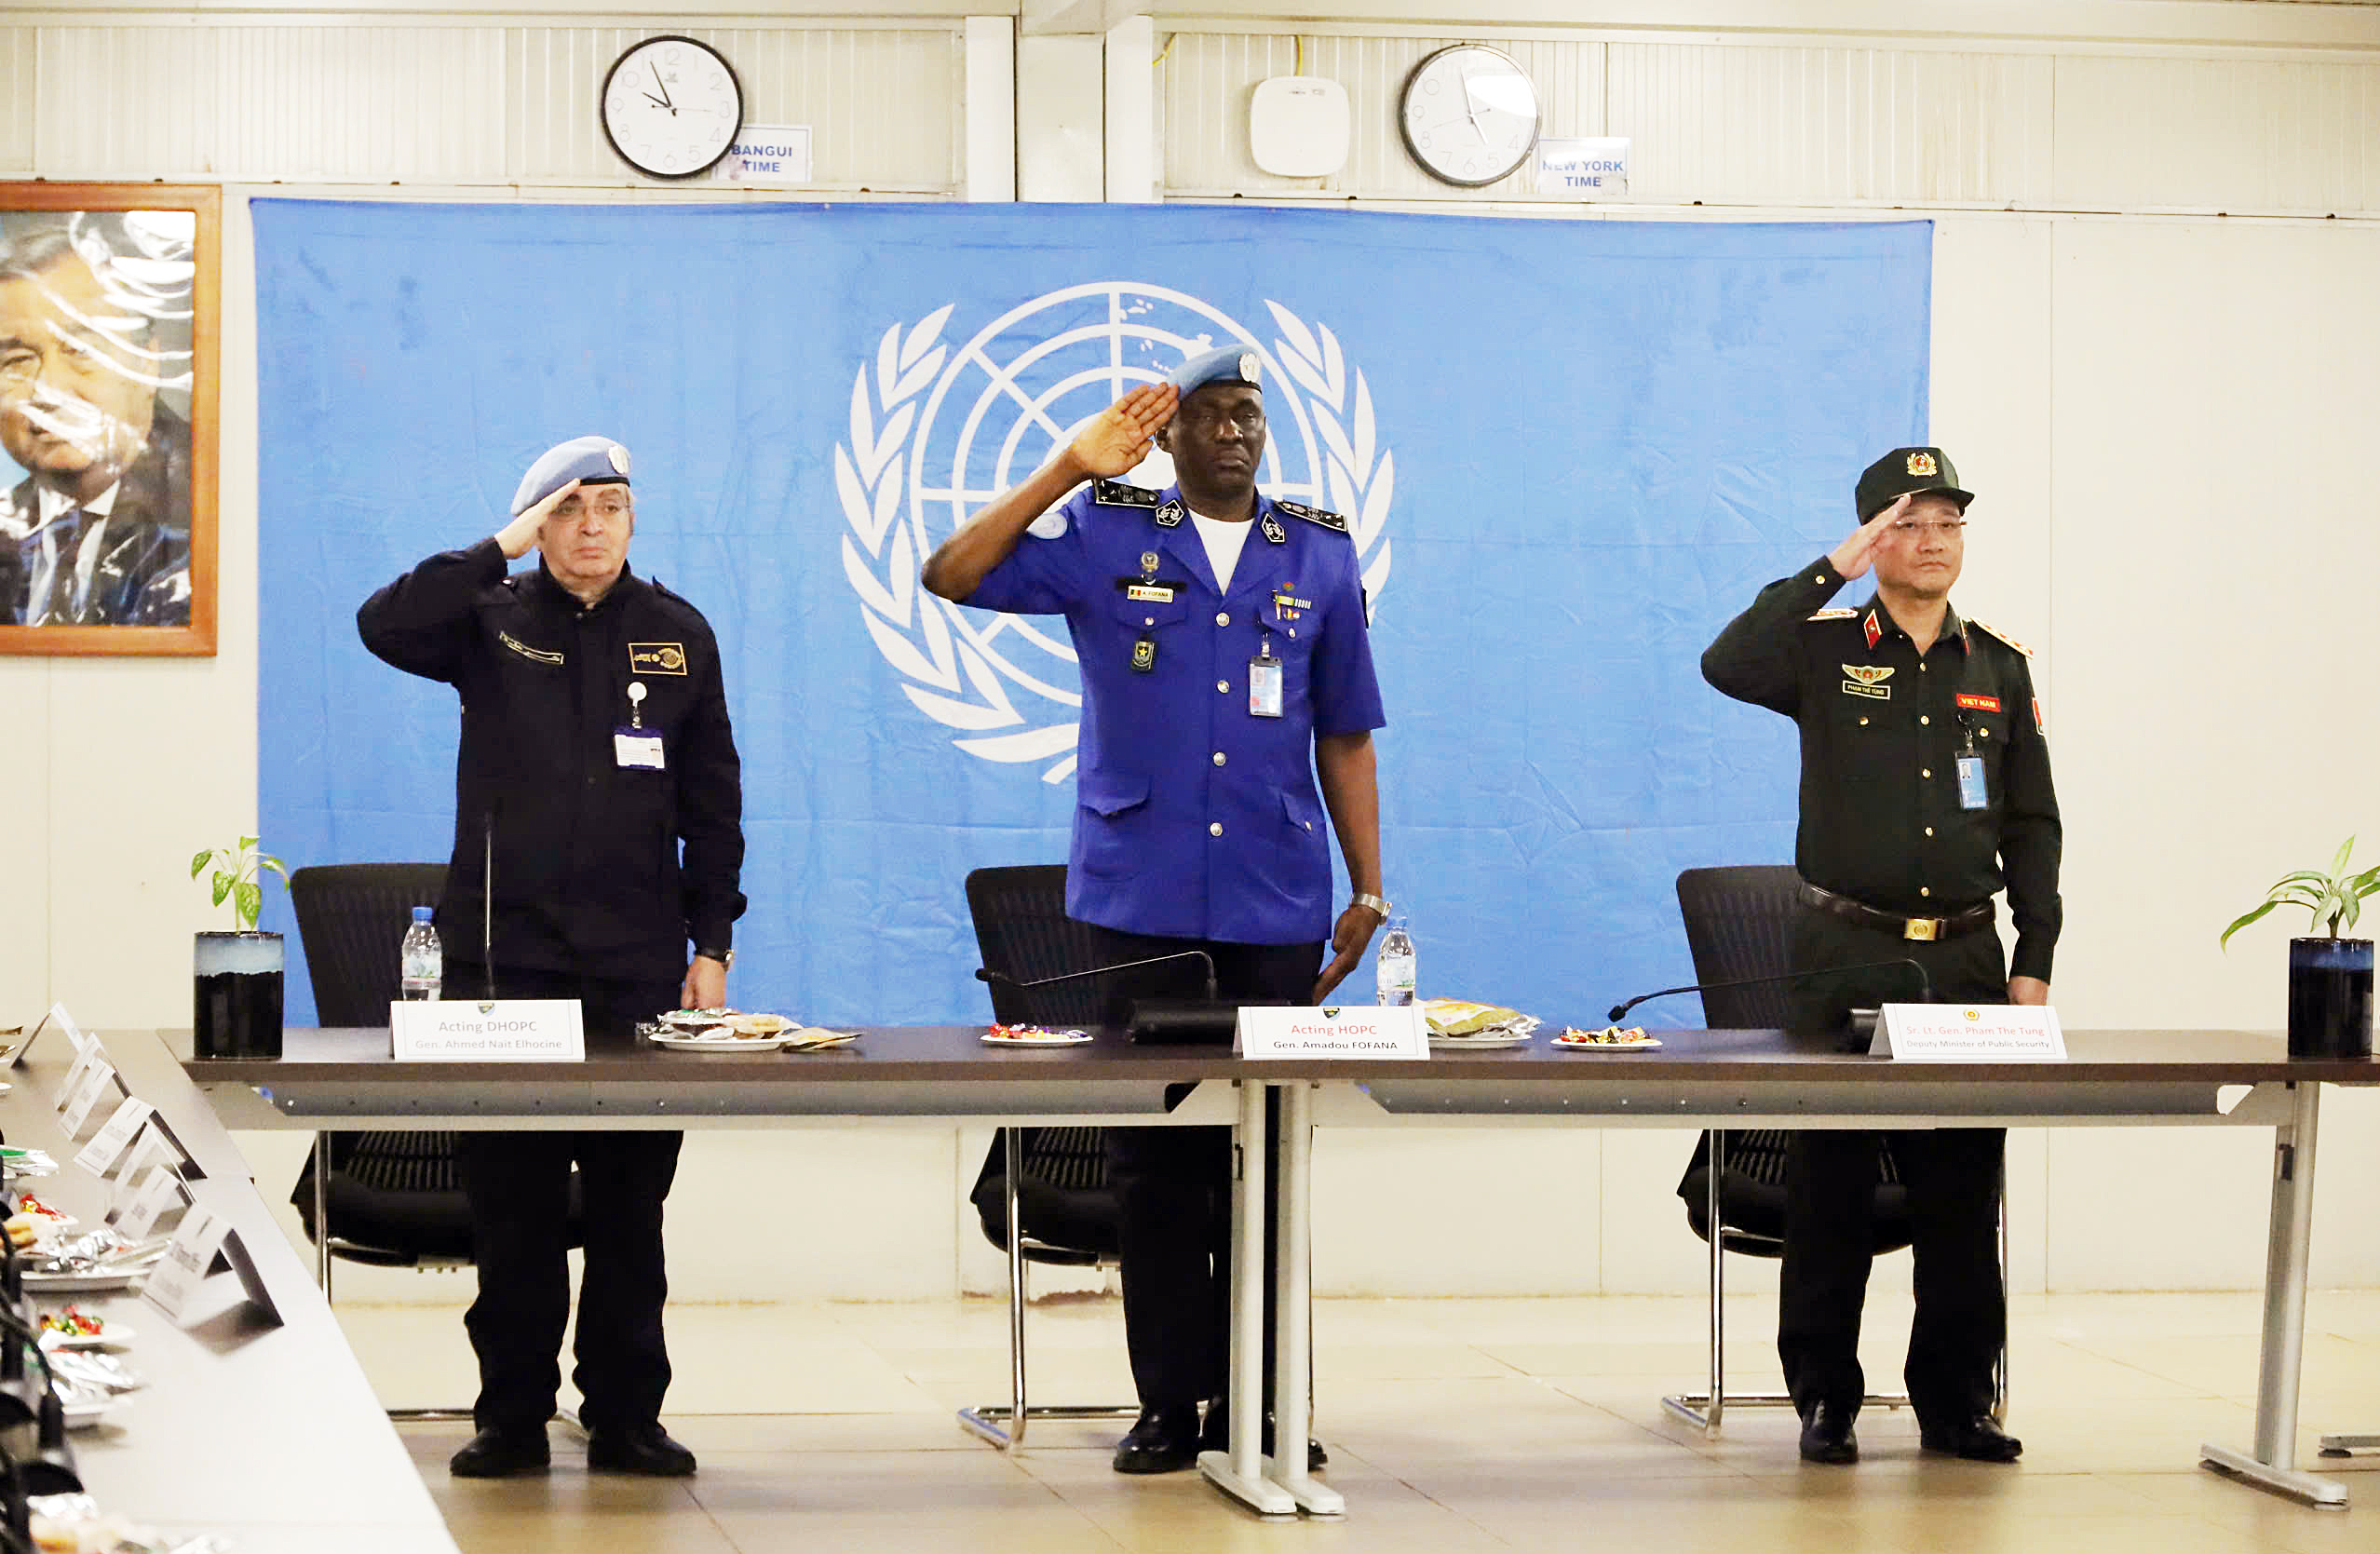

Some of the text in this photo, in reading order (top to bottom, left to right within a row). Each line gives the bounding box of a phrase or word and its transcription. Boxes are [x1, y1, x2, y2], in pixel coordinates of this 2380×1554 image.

[731, 144, 792, 156] BANGUI
[743, 160, 780, 172] TIME
[1543, 160, 1624, 171] NEW YORK
[1564, 176, 1602, 187] TIME
[1980, 699, 1996, 709] NAM
[439, 1020, 537, 1034] Acting DHOPC
[1291, 1024, 1377, 1036] Acting HOPC
[1906, 1026, 2046, 1036] Sr. Lt. Gen. Pham The Tung
[415, 1040, 562, 1049] Gen. Ahmed Nait Elhocine
[1273, 1041, 1399, 1049] Gen. Amadou FOFANA
[1907, 1040, 2049, 1049] Deputy Minister of Public Security
